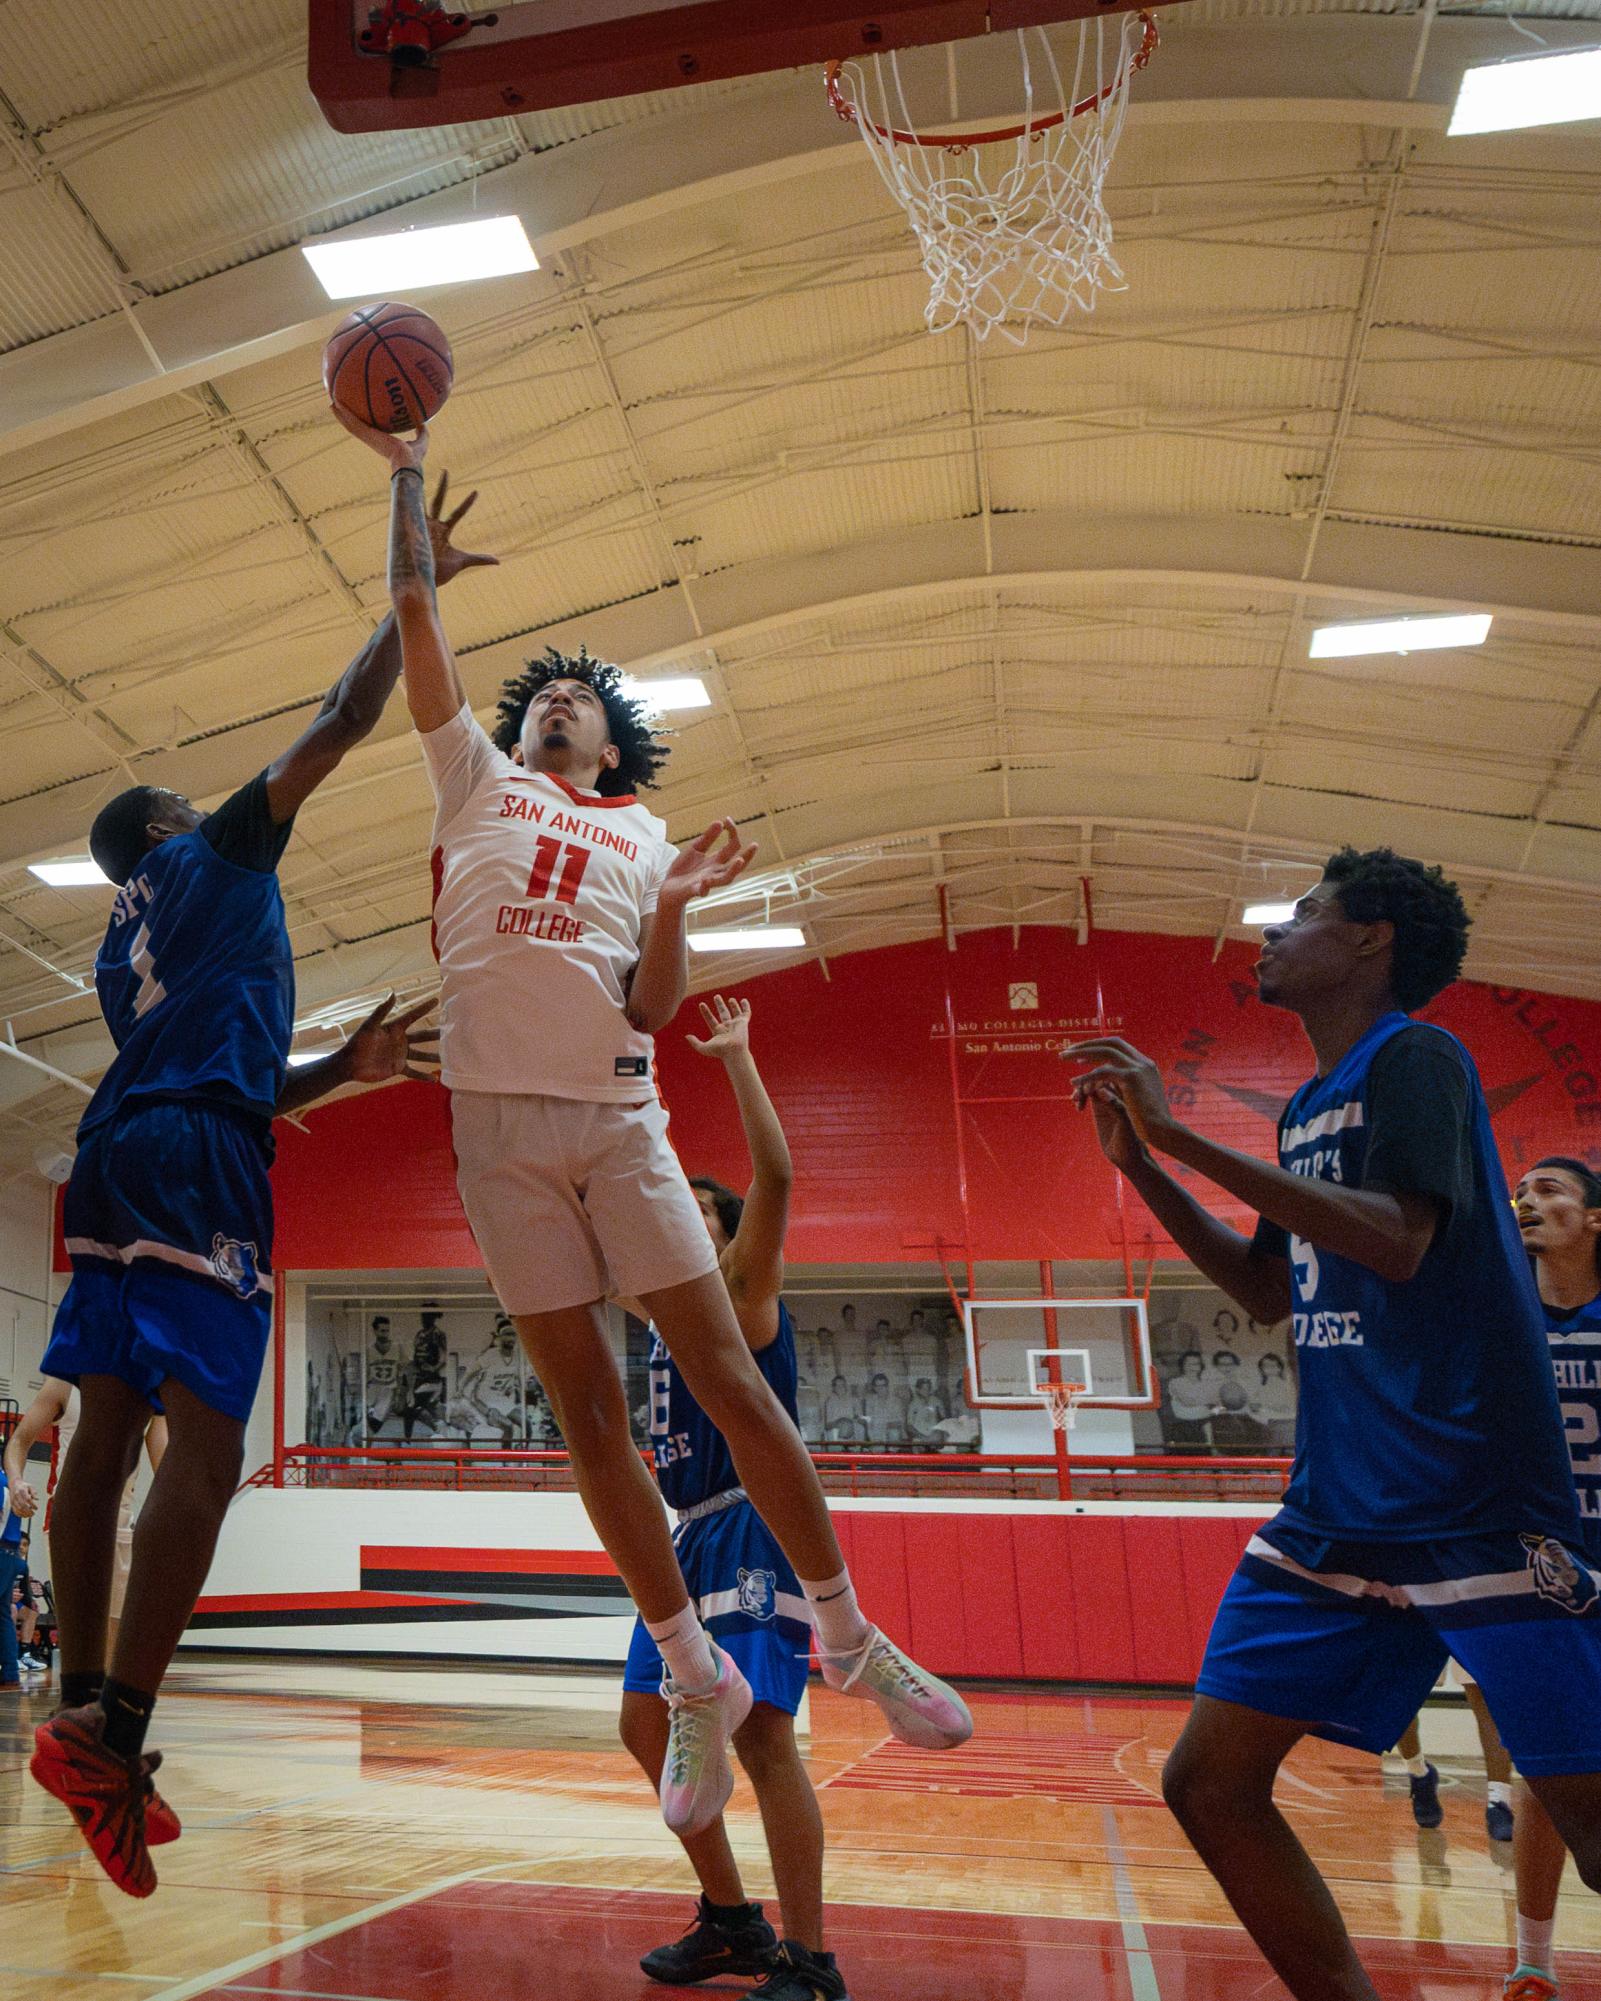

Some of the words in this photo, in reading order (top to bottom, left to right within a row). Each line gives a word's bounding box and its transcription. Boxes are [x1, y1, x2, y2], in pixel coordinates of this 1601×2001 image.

[500, 795, 546, 825] SAN
[549, 812, 638, 863] ANTONIO
[526, 834, 592, 906] 11
[496, 905, 585, 943] COLLEGE
[931, 1022, 978, 1033] ALMO
[1059, 1016, 1124, 1028] DISTRCT
[965, 1041, 988, 1054] San
[992, 1040, 1042, 1053] Antonio
[1045, 1038, 1074, 1051] Coll
[1491, 984, 1601, 1128] OLLEGE
